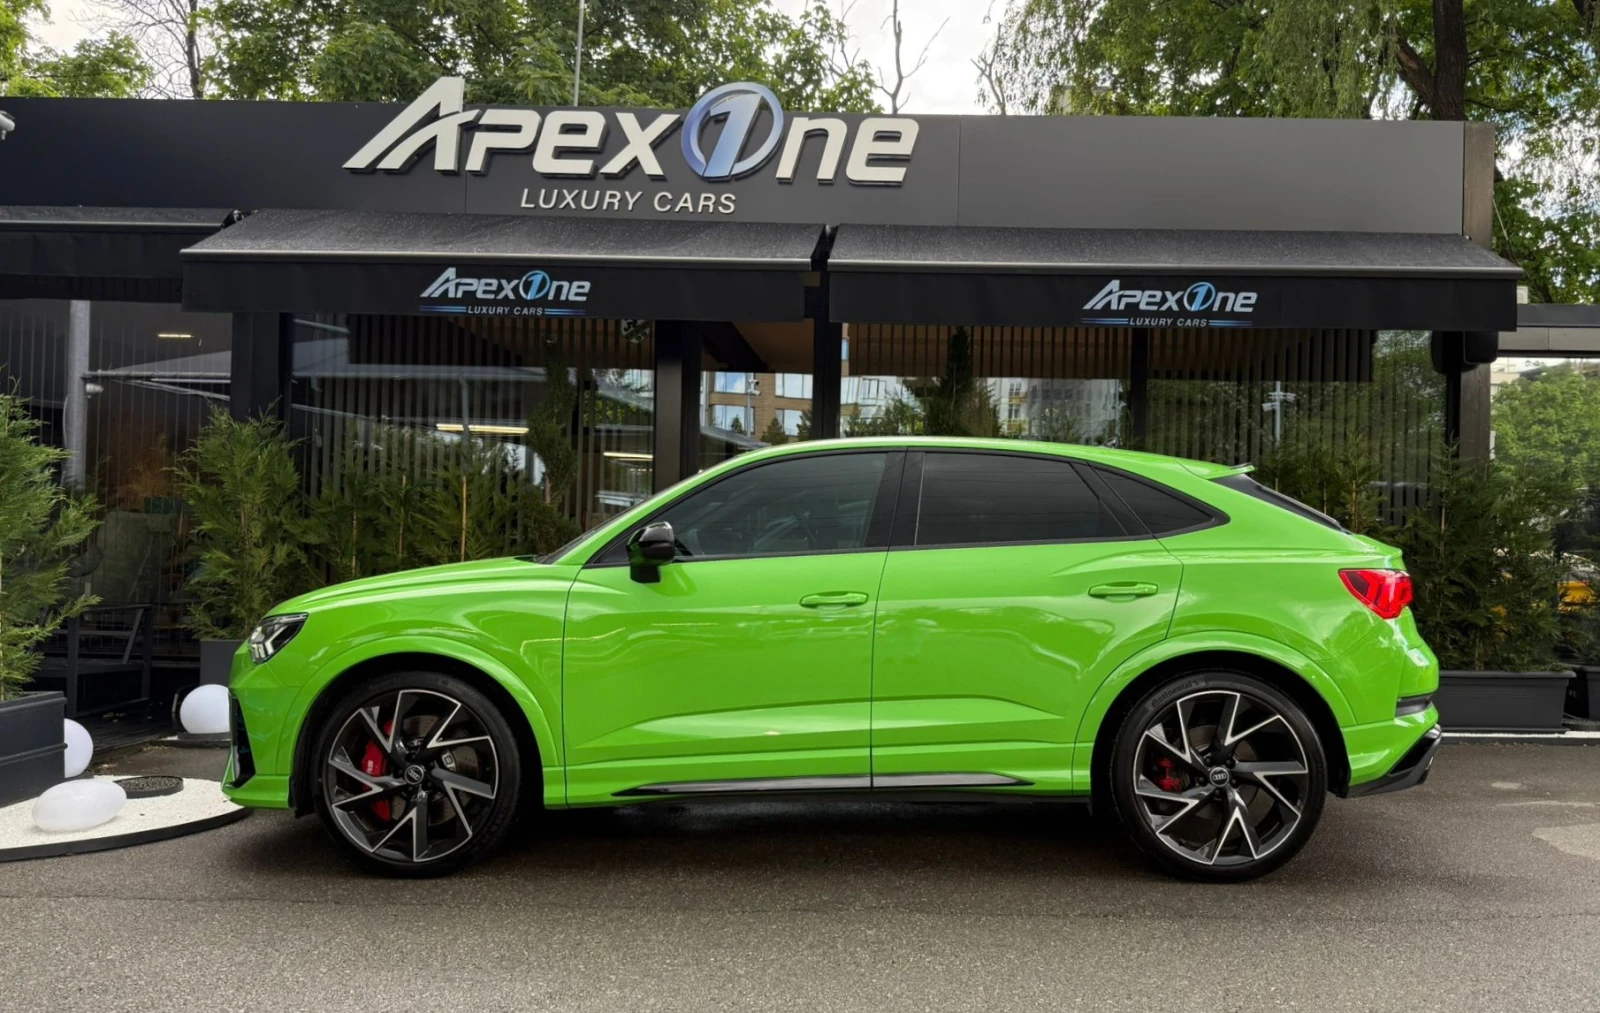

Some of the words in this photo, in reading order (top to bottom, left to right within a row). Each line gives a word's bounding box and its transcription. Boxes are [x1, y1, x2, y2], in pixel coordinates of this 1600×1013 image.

[520, 187, 642, 211] LUXURY
[653, 191, 736, 214] CARS
[467, 305, 510, 316] LUXURY
[513, 306, 543, 316] CARS
[1129, 317, 1174, 327] LUXURY
[1176, 318, 1207, 328] CARS
